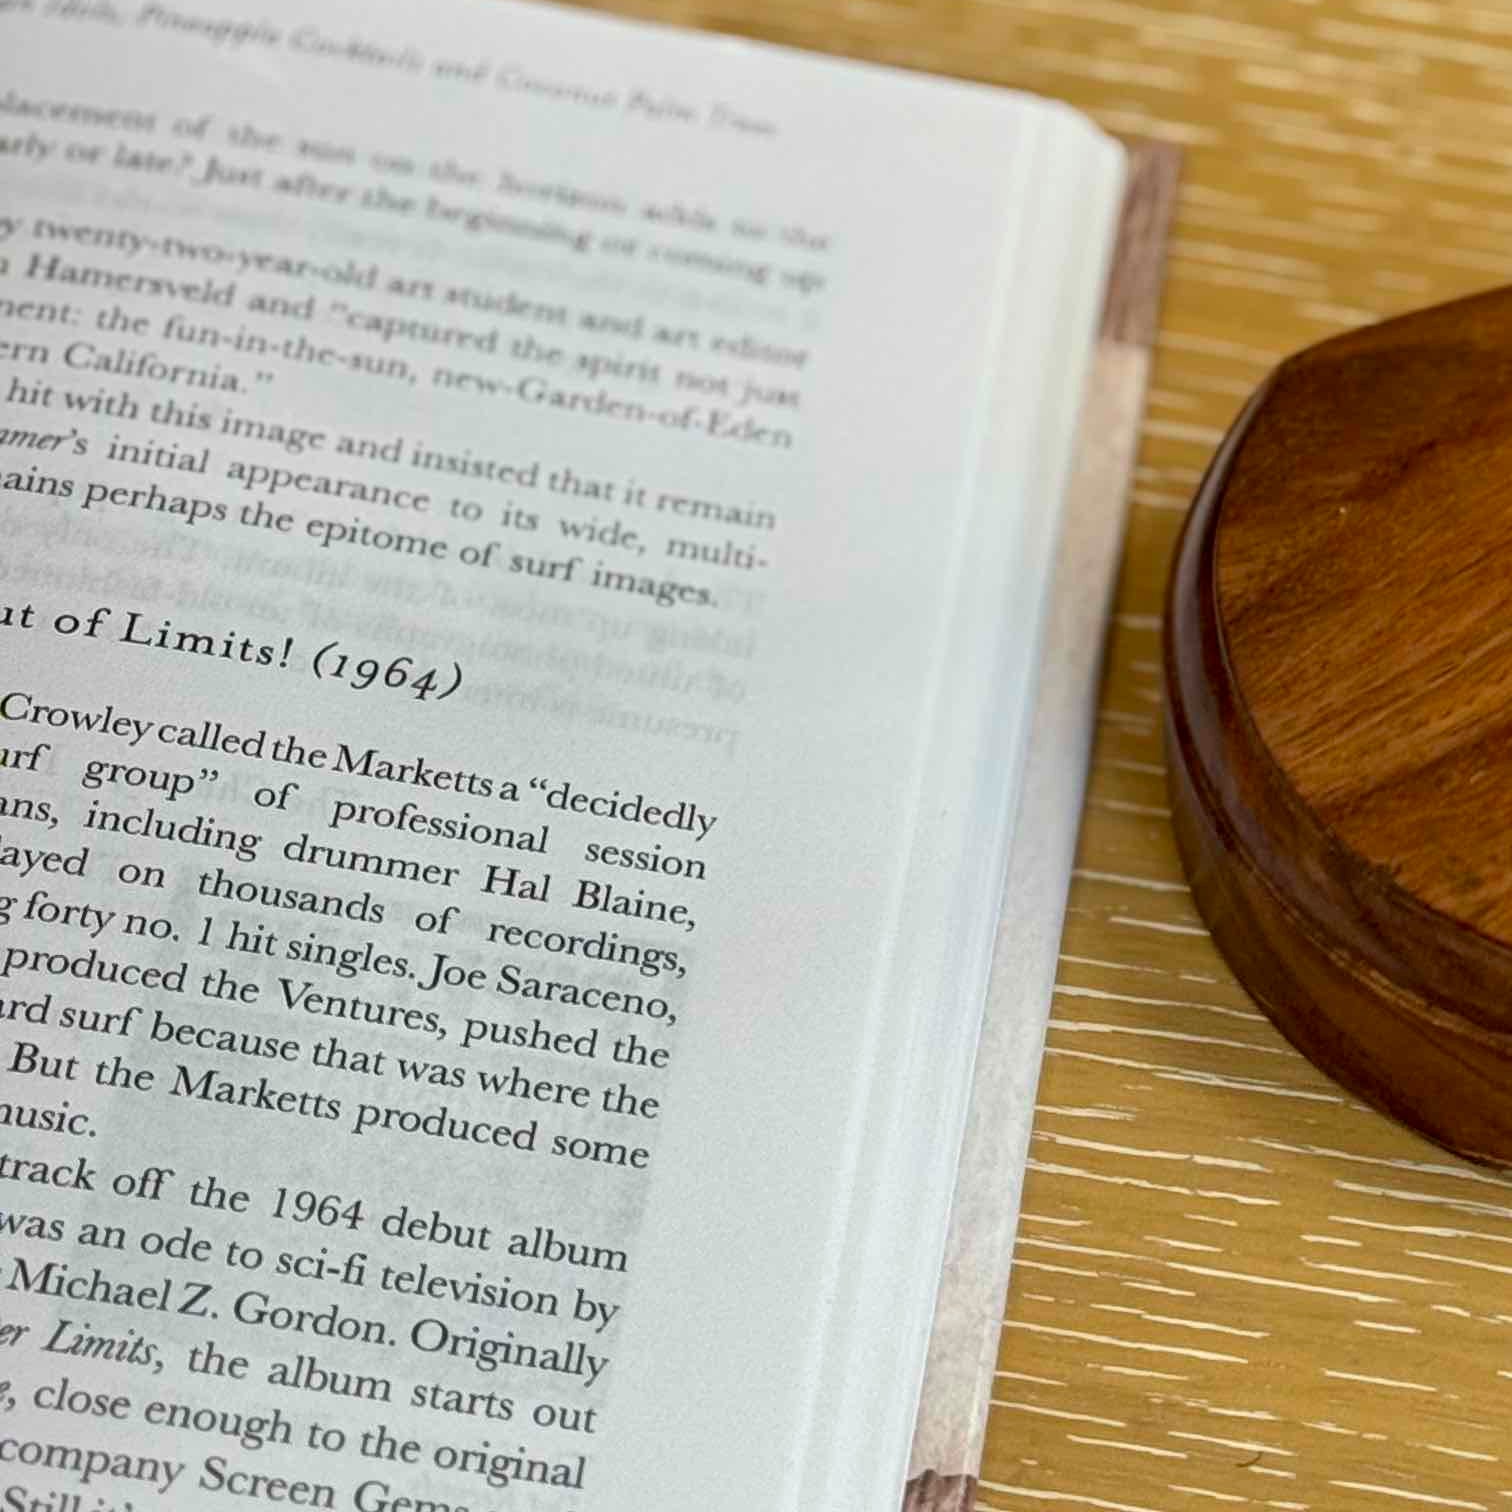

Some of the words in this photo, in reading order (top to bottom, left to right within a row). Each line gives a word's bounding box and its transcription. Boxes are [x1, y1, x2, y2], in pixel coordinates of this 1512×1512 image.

[0, 90, 157, 133] lacement
[25, 252, 236, 307] Hamersveld
[247, 296, 315, 320] and
[510, 336, 563, 365] the
[574, 354, 660, 384] spirit
[676, 372, 728, 396] not
[32, 219, 379, 290] twenty-two-year-old
[386, 278, 435, 300] art
[445, 288, 567, 325] student
[579, 314, 643, 339] and
[652, 328, 699, 348] art
[96, 306, 149, 334] the
[162, 315, 416, 385] fun-in-the-sun,
[432, 368, 792, 448] new-Garden-of-Eden
[5, 376, 54, 408] hit
[64, 388, 139, 420] with
[150, 399, 212, 430] this
[220, 408, 326, 453] image
[336, 436, 403, 463] and
[411, 442, 539, 488] insisted
[549, 468, 614, 502] that
[624, 478, 646, 507] it
[656, 495, 775, 529] remain
[106, 434, 210, 474] initial
[226, 462, 430, 512] appearance
[450, 498, 483, 521] to
[501, 502, 539, 531] its
[560, 520, 645, 556] wide,
[666, 539, 766, 570] multi-
[0, 466, 74, 497] ains
[81, 484, 227, 525] perhaps
[240, 501, 294, 531] the
[307, 518, 447, 558] epitome
[460, 543, 500, 567] of
[510, 556, 582, 581] surf
[592, 562, 718, 606] images.
[54, 608, 111, 638] of
[119, 612, 293, 668] Limits!
[313, 642, 462, 701] (1964)
[0, 693, 154, 746] Crowley
[158, 721, 266, 758] called
[272, 736, 327, 768] the
[331, 744, 493, 797] Marketts
[499, 782, 519, 801] a
[530, 777, 717, 842] “decidedly
[82, 761, 218, 801] group”
[254, 783, 299, 810] of
[328, 801, 549, 853] professional
[585, 844, 705, 880] session
[0, 835, 89, 877] ayed
[119, 864, 164, 888] on
[199, 868, 384, 923] thousands
[415, 907, 460, 934] of
[486, 924, 686, 979] recordings,
[83, 800, 262, 862] including
[284, 833, 460, 886] drummer
[480, 864, 550, 902] Hal
[572, 880, 695, 932] Blaine,
[0, 948, 188, 992] produced
[202, 969, 259, 1003] the
[278, 978, 446, 1040] Ventures,
[460, 1019, 598, 1058] pushed
[613, 1035, 669, 1068] the
[23, 891, 116, 938] forty
[123, 915, 179, 942] no.
[198, 917, 212, 946] 1
[225, 920, 278, 956] hit
[286, 933, 415, 979] singles.
[417, 953, 487, 991] Joe
[496, 965, 676, 1027] Saraceno,
[0, 994, 52, 1024] rd
[59, 1007, 142, 1036] surf
[151, 1010, 300, 1061] because
[313, 1037, 386, 1076] that
[398, 1059, 465, 1088] was
[477, 1067, 590, 1108] where
[603, 1083, 659, 1119] the
[7, 1042, 79, 1080] But
[96, 1056, 154, 1091] the
[168, 1065, 341, 1120] Marketts
[351, 1104, 537, 1151] produced
[552, 1136, 649, 1169] some
[0, 1154, 96, 1190] track
[113, 1168, 175, 1200] off
[191, 1176, 250, 1212] the
[273, 1188, 364, 1230] 1964
[382, 1206, 491, 1250] debut
[508, 1227, 627, 1272] album
[5, 1257, 171, 1311] Michael
[177, 1282, 218, 1319] Z.
[234, 1291, 395, 1346] Gordon.
[411, 1319, 610, 1387] Originally
[78, 1224, 125, 1250] an
[141, 1227, 212, 1261] ode
[227, 1241, 263, 1269] to
[276, 1248, 367, 1286] sci-fi
[381, 1263, 557, 1316] television
[574, 1288, 620, 1334] by
[34, 1378, 131, 1419] close
[145, 1402, 291, 1450] enough
[308, 1423, 346, 1451] to
[360, 1425, 421, 1463] the
[434, 1441, 586, 1489] original
[41, 1319, 163, 1374] Limits,
[189, 1341, 248, 1379] the
[268, 1355, 390, 1402] album
[411, 1384, 514, 1421] starts
[533, 1405, 597, 1433] out
[0, 1439, 185, 1494] company
[199, 1456, 334, 1509] Screen
